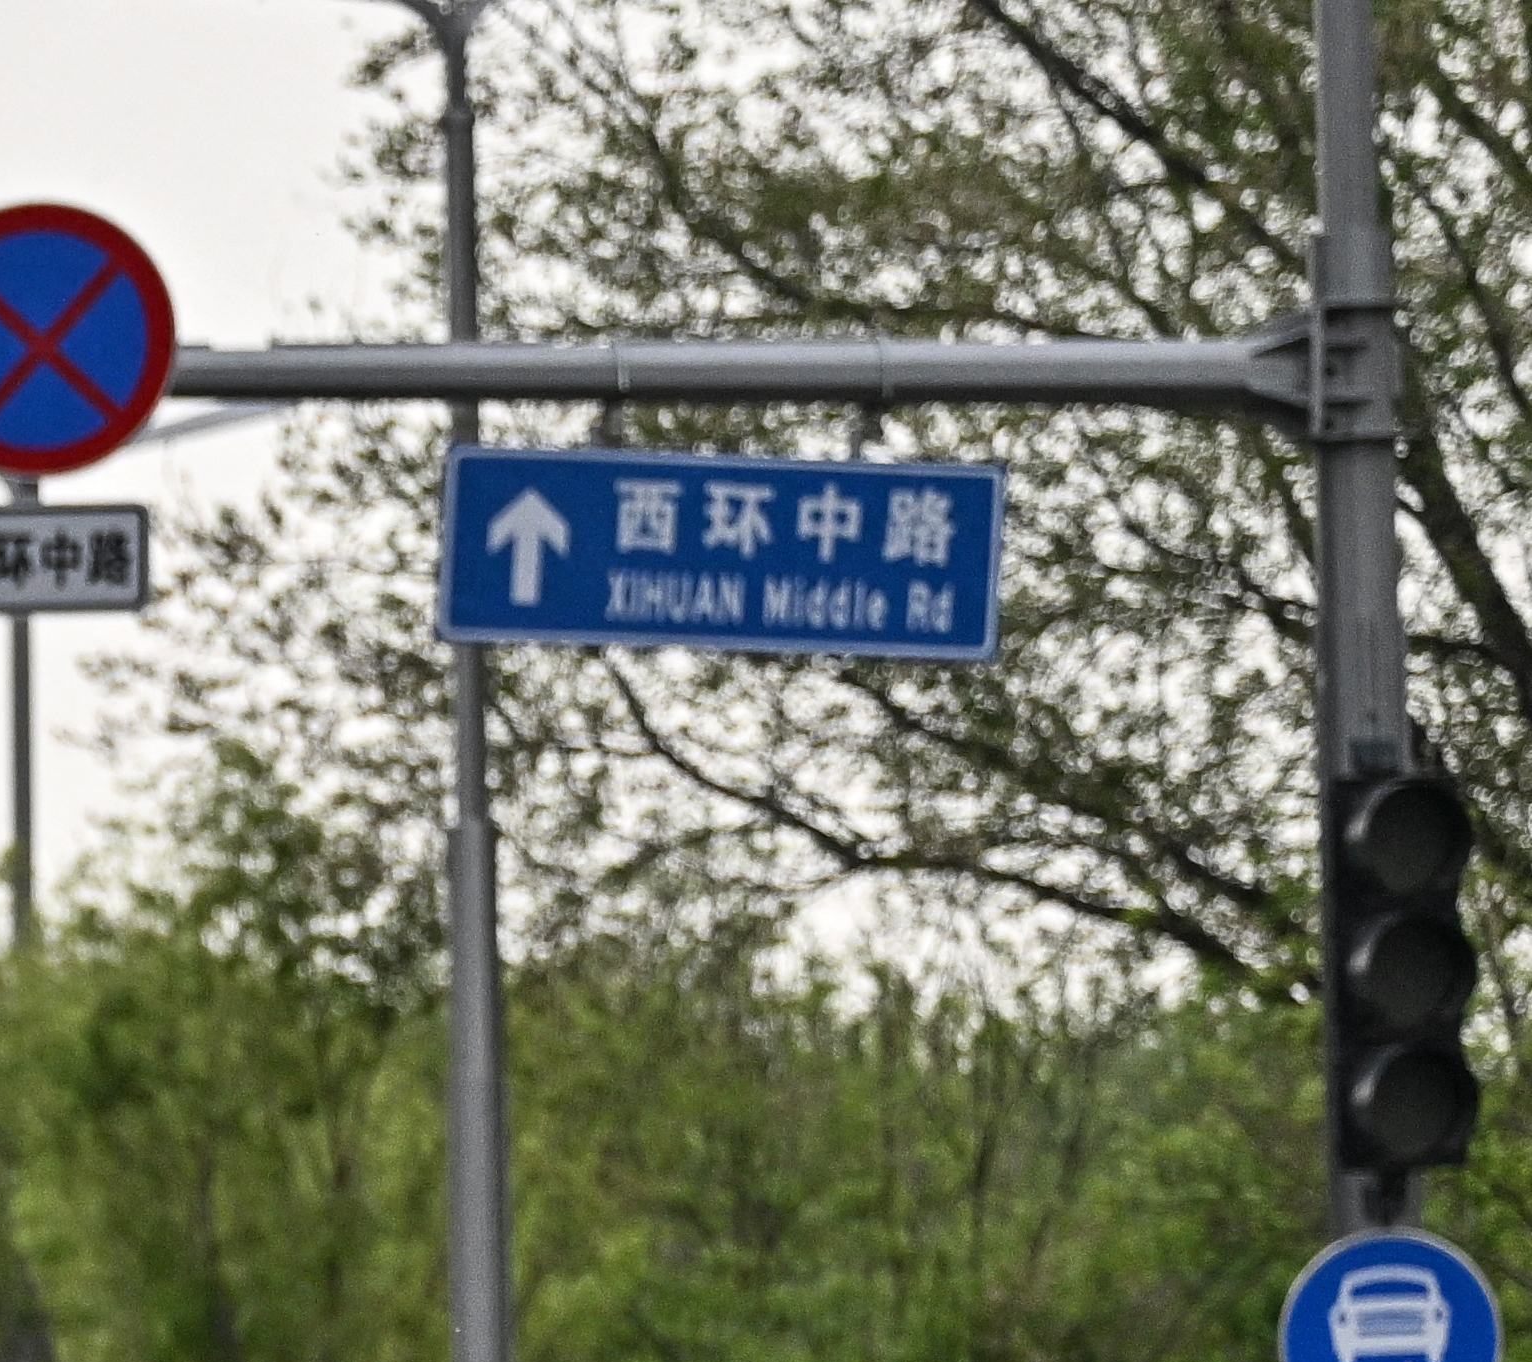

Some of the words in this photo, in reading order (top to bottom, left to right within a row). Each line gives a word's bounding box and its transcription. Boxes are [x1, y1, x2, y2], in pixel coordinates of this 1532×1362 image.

[613, 476, 957, 566] 西环中路
[763, 575, 890, 630] Middle
[906, 579, 955, 632] Rd
